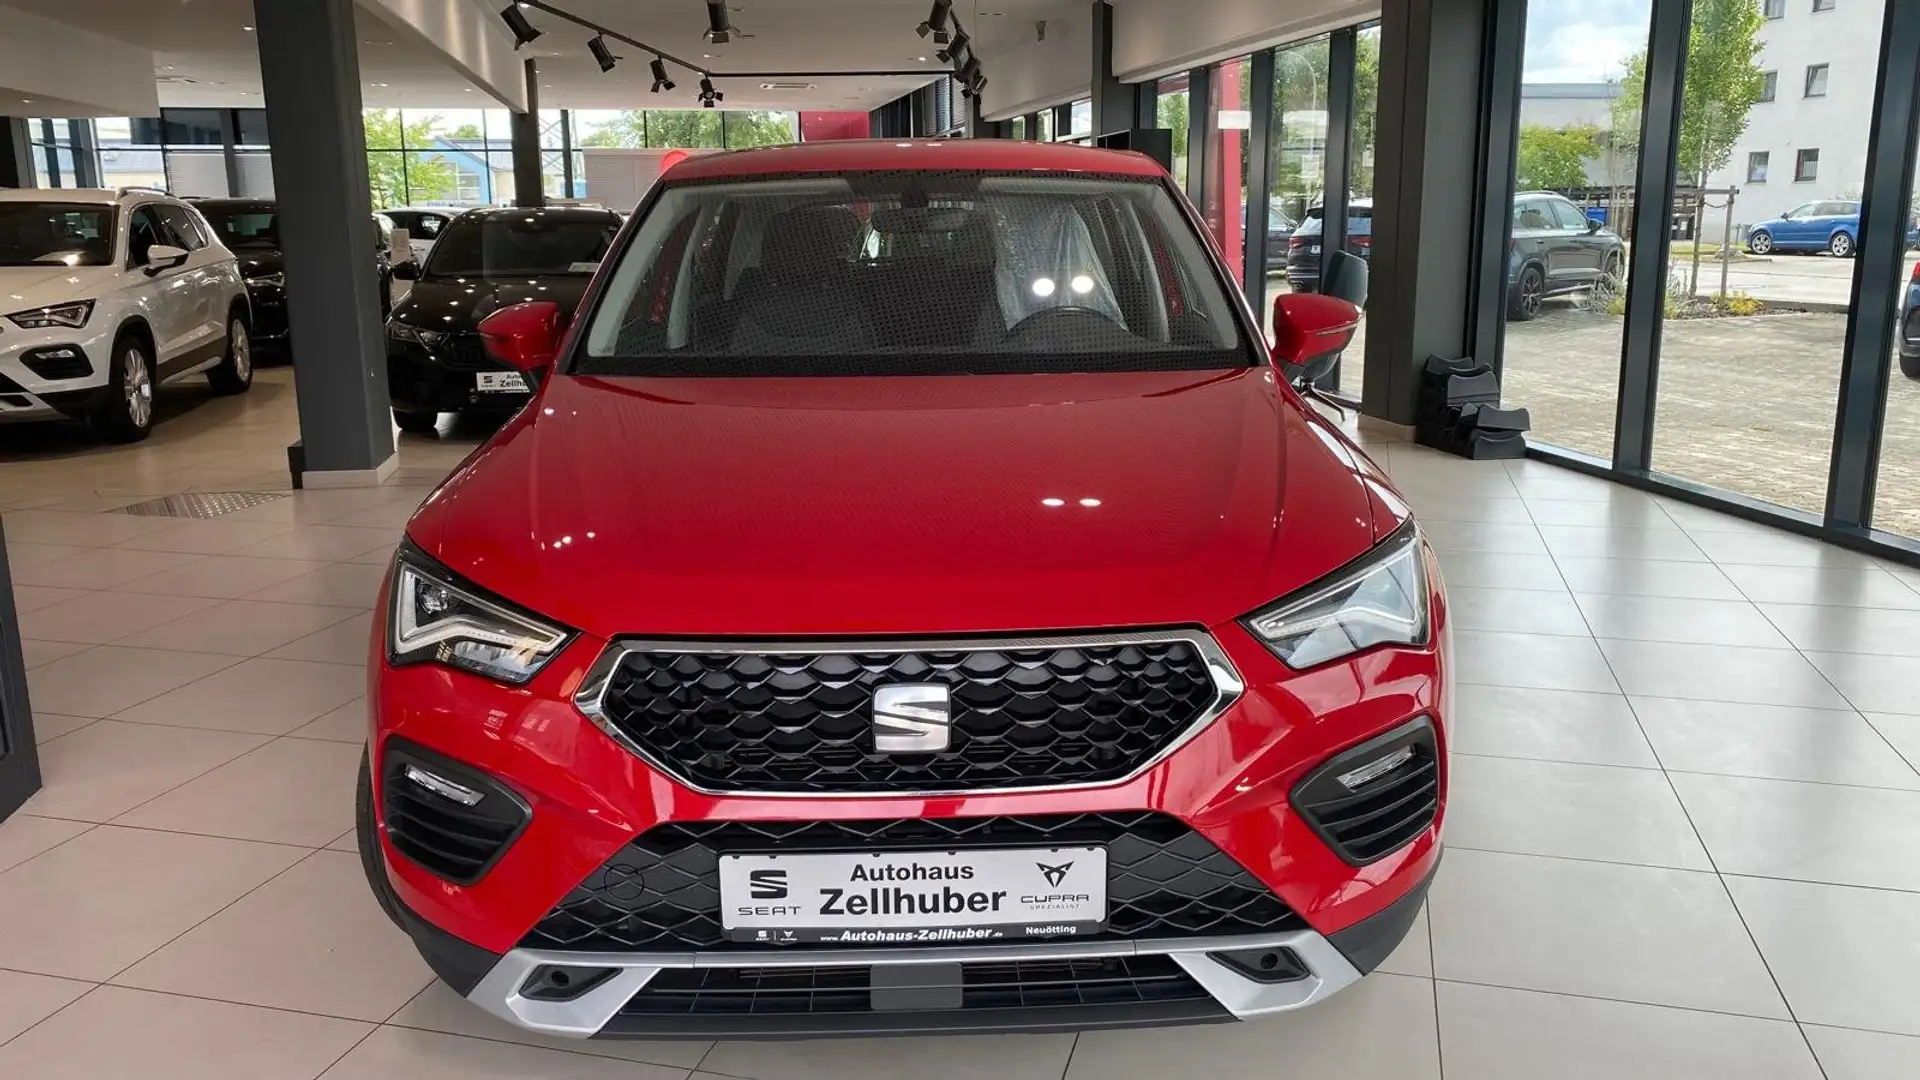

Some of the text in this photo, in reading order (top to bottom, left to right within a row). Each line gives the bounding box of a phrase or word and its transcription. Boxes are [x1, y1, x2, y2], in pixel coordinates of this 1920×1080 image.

[850, 862, 974, 882] Autohaus
[819, 886, 1007, 916] Zellhuber
[1020, 893, 1090, 904] CUPRA
[738, 906, 801, 916] SEAT
[1025, 925, 1077, 936] Neuötting
